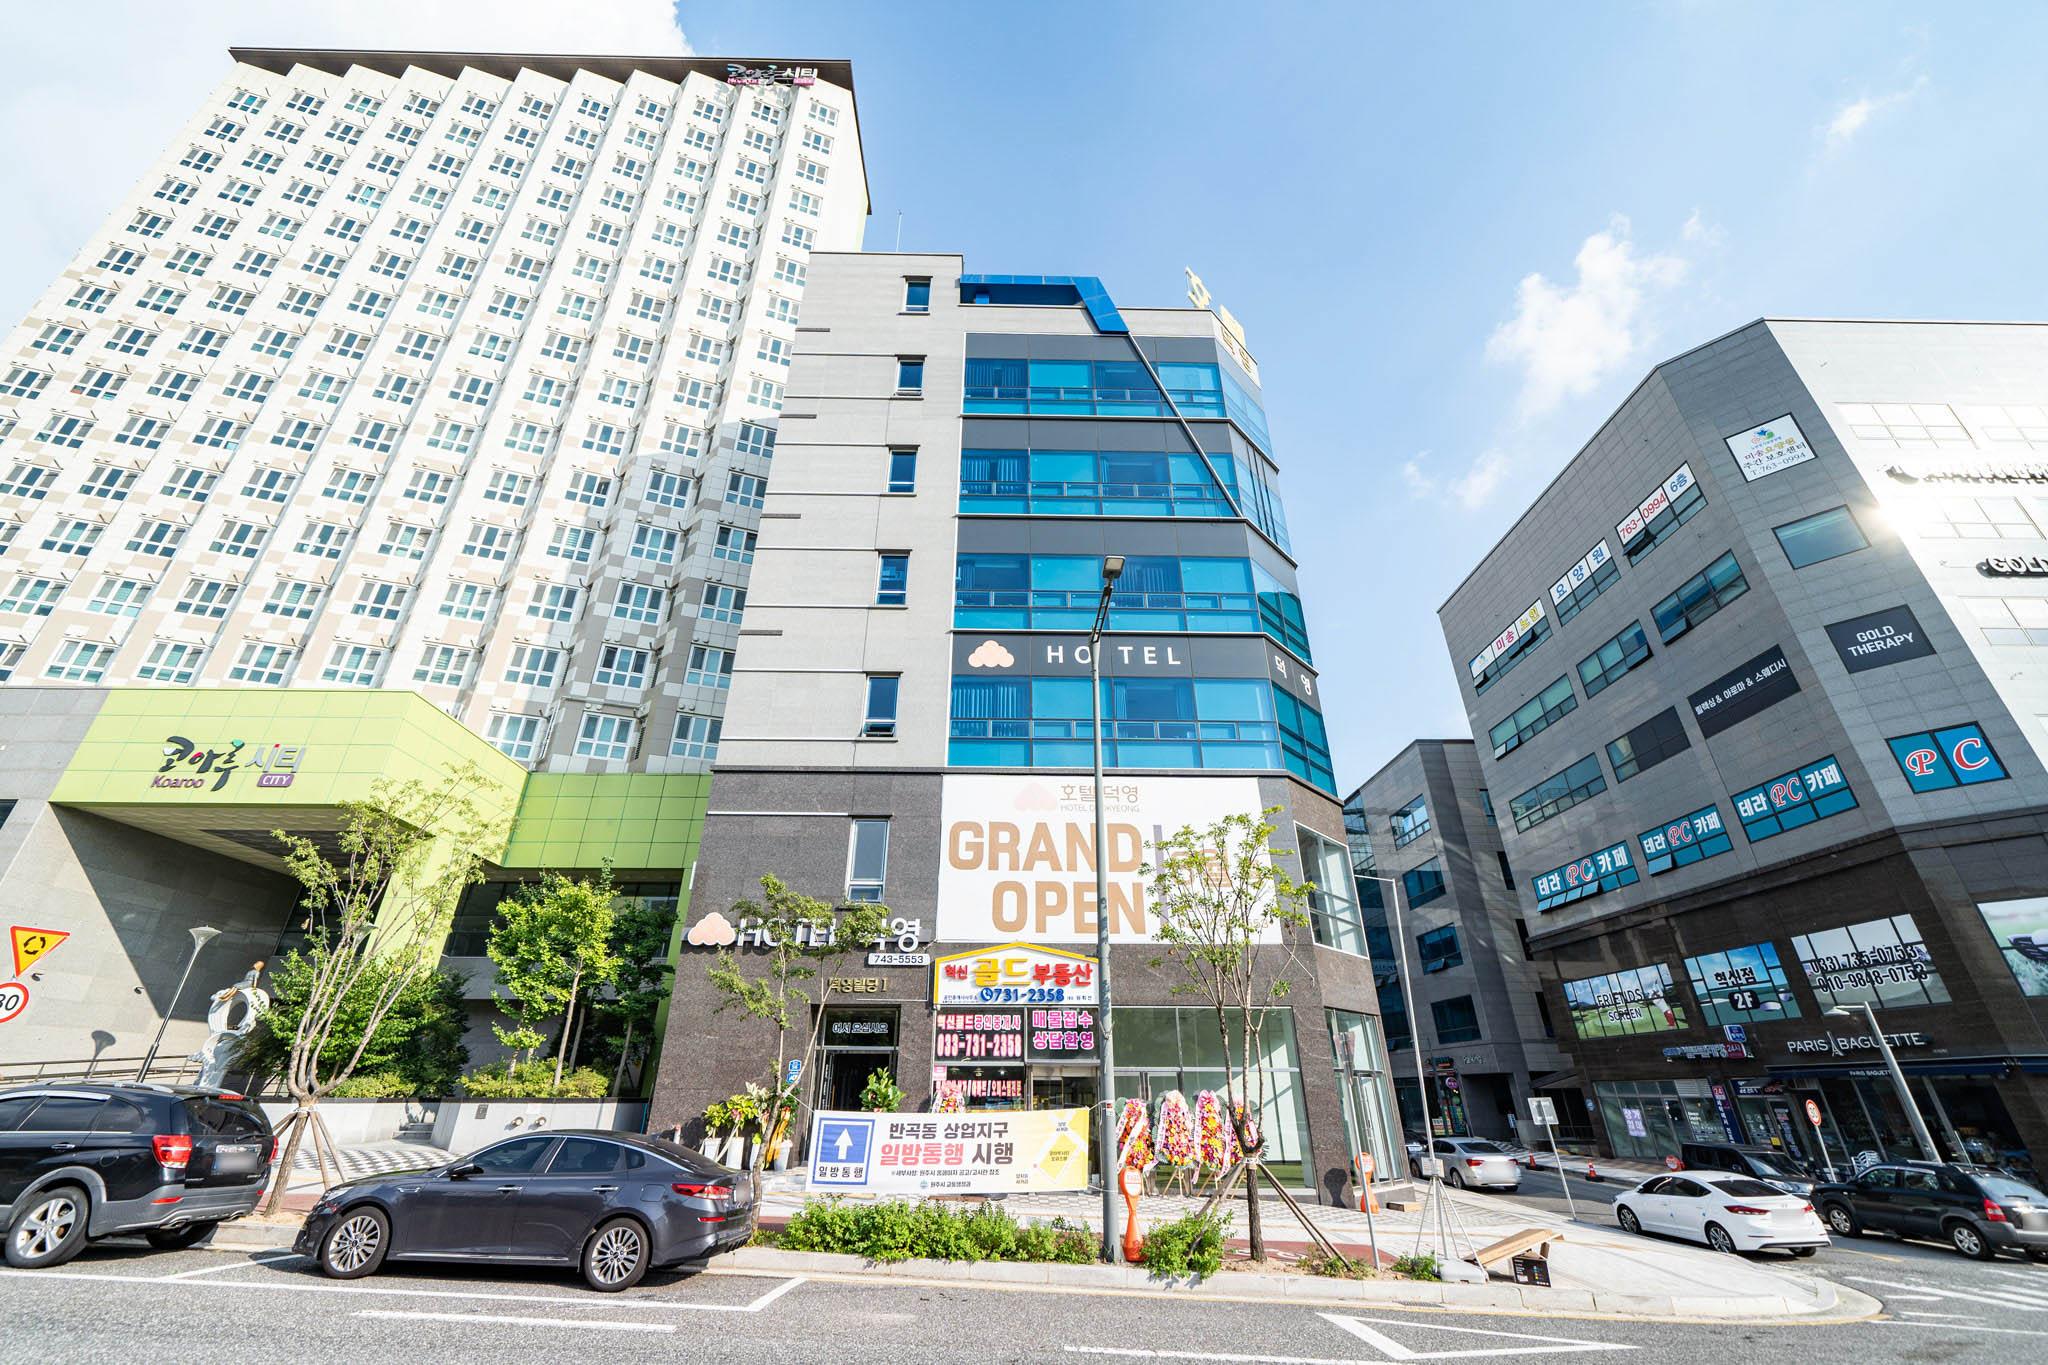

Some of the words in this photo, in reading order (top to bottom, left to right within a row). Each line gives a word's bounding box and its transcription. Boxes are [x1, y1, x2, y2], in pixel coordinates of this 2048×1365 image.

[1495, 630, 1515, 651] 미송
[1519, 606, 1540, 629] 노인
[1619, 492, 1667, 540] 763-0994
[1669, 473, 1689, 494] 6층
[1855, 624, 1895, 643] GOLD
[1847, 632, 1915, 657] THERAPY
[1047, 645, 1182, 666] HOTEL
[1723, 682, 1747, 700] 아로마
[1746, 678, 1753, 687] &
[159, 736, 245, 792] 코아루
[245, 744, 305, 773] 시티
[1904, 737, 1990, 776] PC
[151, 775, 204, 789] Koaroo
[262, 775, 291, 785] CITY
[1103, 785, 1138, 803] 덕영
[1738, 793, 1768, 818] 테라
[1769, 777, 1803, 808] PC
[1804, 764, 1842, 793] 카페
[1643, 833, 1666, 855] 테라
[1667, 821, 1693, 847] PC
[1693, 811, 1720, 835] 카페
[948, 821, 1143, 873] GRAND
[1537, 873, 1562, 897] 테라
[1565, 858, 1595, 886] PC
[1596, 846, 1629, 873] 카페
[992, 880, 1146, 935] OPEN
[874, 955, 924, 964] 743-5553
[943, 964, 968, 981] 혁신
[972, 958, 1032, 987] 골드
[1032, 963, 1093, 987] 부동산
[1713, 967, 1757, 986] 혁신점
[992, 988, 1065, 1002] 731-2358
[1596, 988, 1644, 1007] FRIENDS
[1733, 991, 1754, 1010] 2F
[1032, 1011, 1094, 1029] 매물접수
[1607, 1008, 1642, 1022] SCREEN
[832, 1022, 851, 1034] 어서
[851, 1022, 889, 1034] 오십시오
[937, 1033, 1022, 1057] 033-731-2358
[1033, 1031, 1094, 1050] 상담환영
[1787, 1038, 1829, 1053] PARIS
[1837, 1032, 1926, 1050] BAGUETTE
[889, 1122, 938, 1140] 반곡동
[943, 1121, 1009, 1139] 상업지구
[880, 1142, 964, 1167] 일방통행
[971, 1143, 1014, 1166] 시행
[818, 1166, 865, 1179] 일방통행
